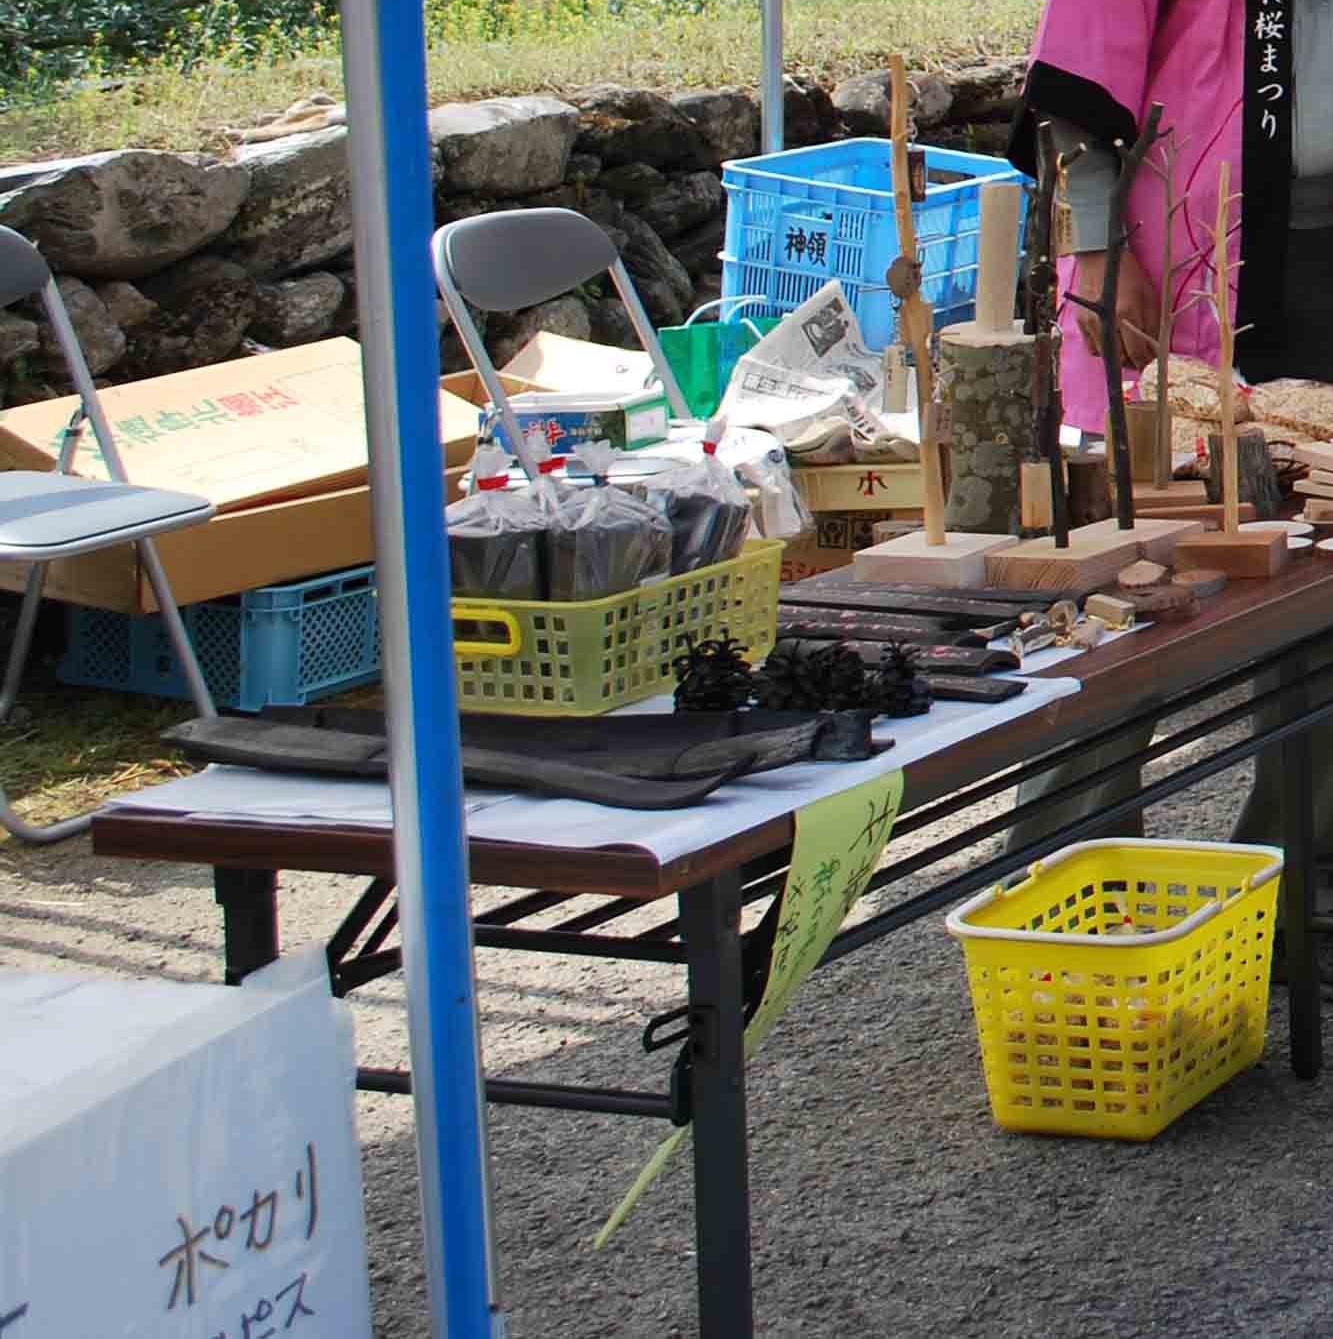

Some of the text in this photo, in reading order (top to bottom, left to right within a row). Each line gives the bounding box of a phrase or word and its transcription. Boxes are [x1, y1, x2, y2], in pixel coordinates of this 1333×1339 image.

[784, 226, 827, 269] 神領
[157, 1141, 320, 1310] ポカリ
[212, 1270, 316, 1339] ピス
